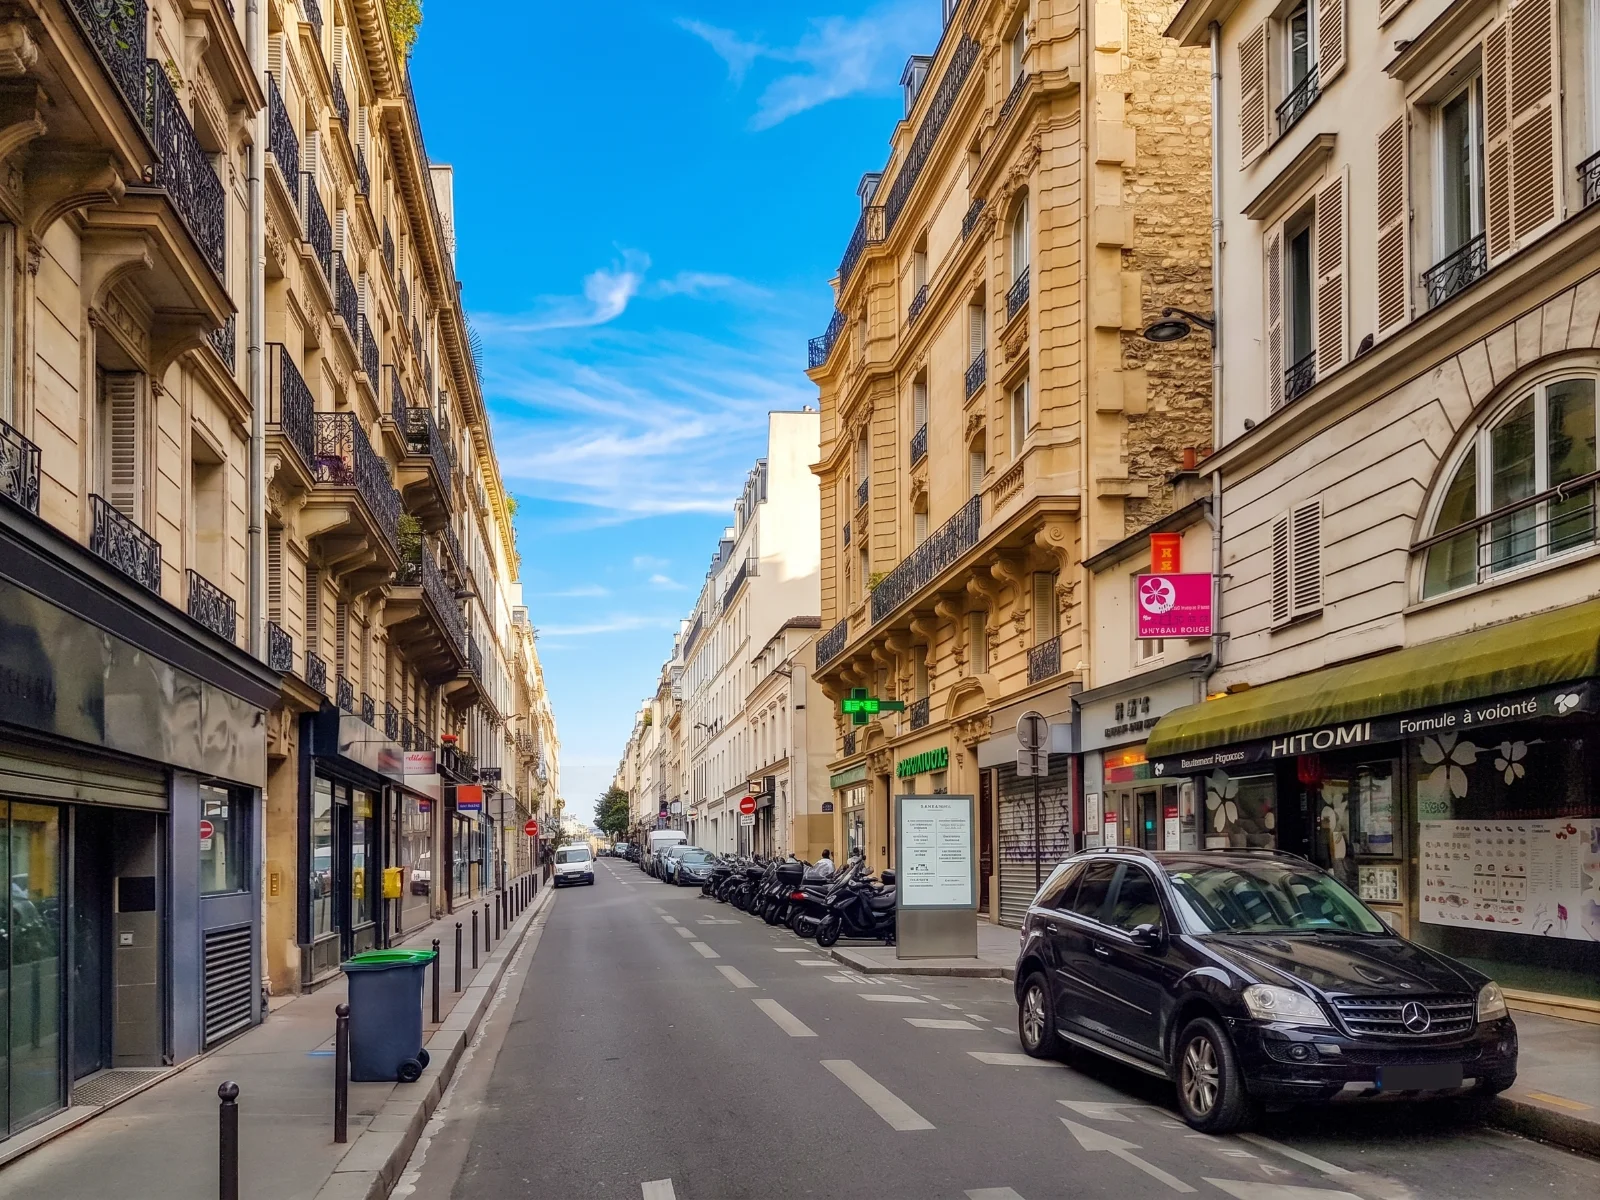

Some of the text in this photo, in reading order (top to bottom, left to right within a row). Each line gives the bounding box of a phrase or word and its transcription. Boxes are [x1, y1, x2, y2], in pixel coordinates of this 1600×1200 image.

[1400, 713, 1456, 734] Formule
[1463, 709, 1472, 724] à
[1271, 722, 1371, 757] HITOMI
